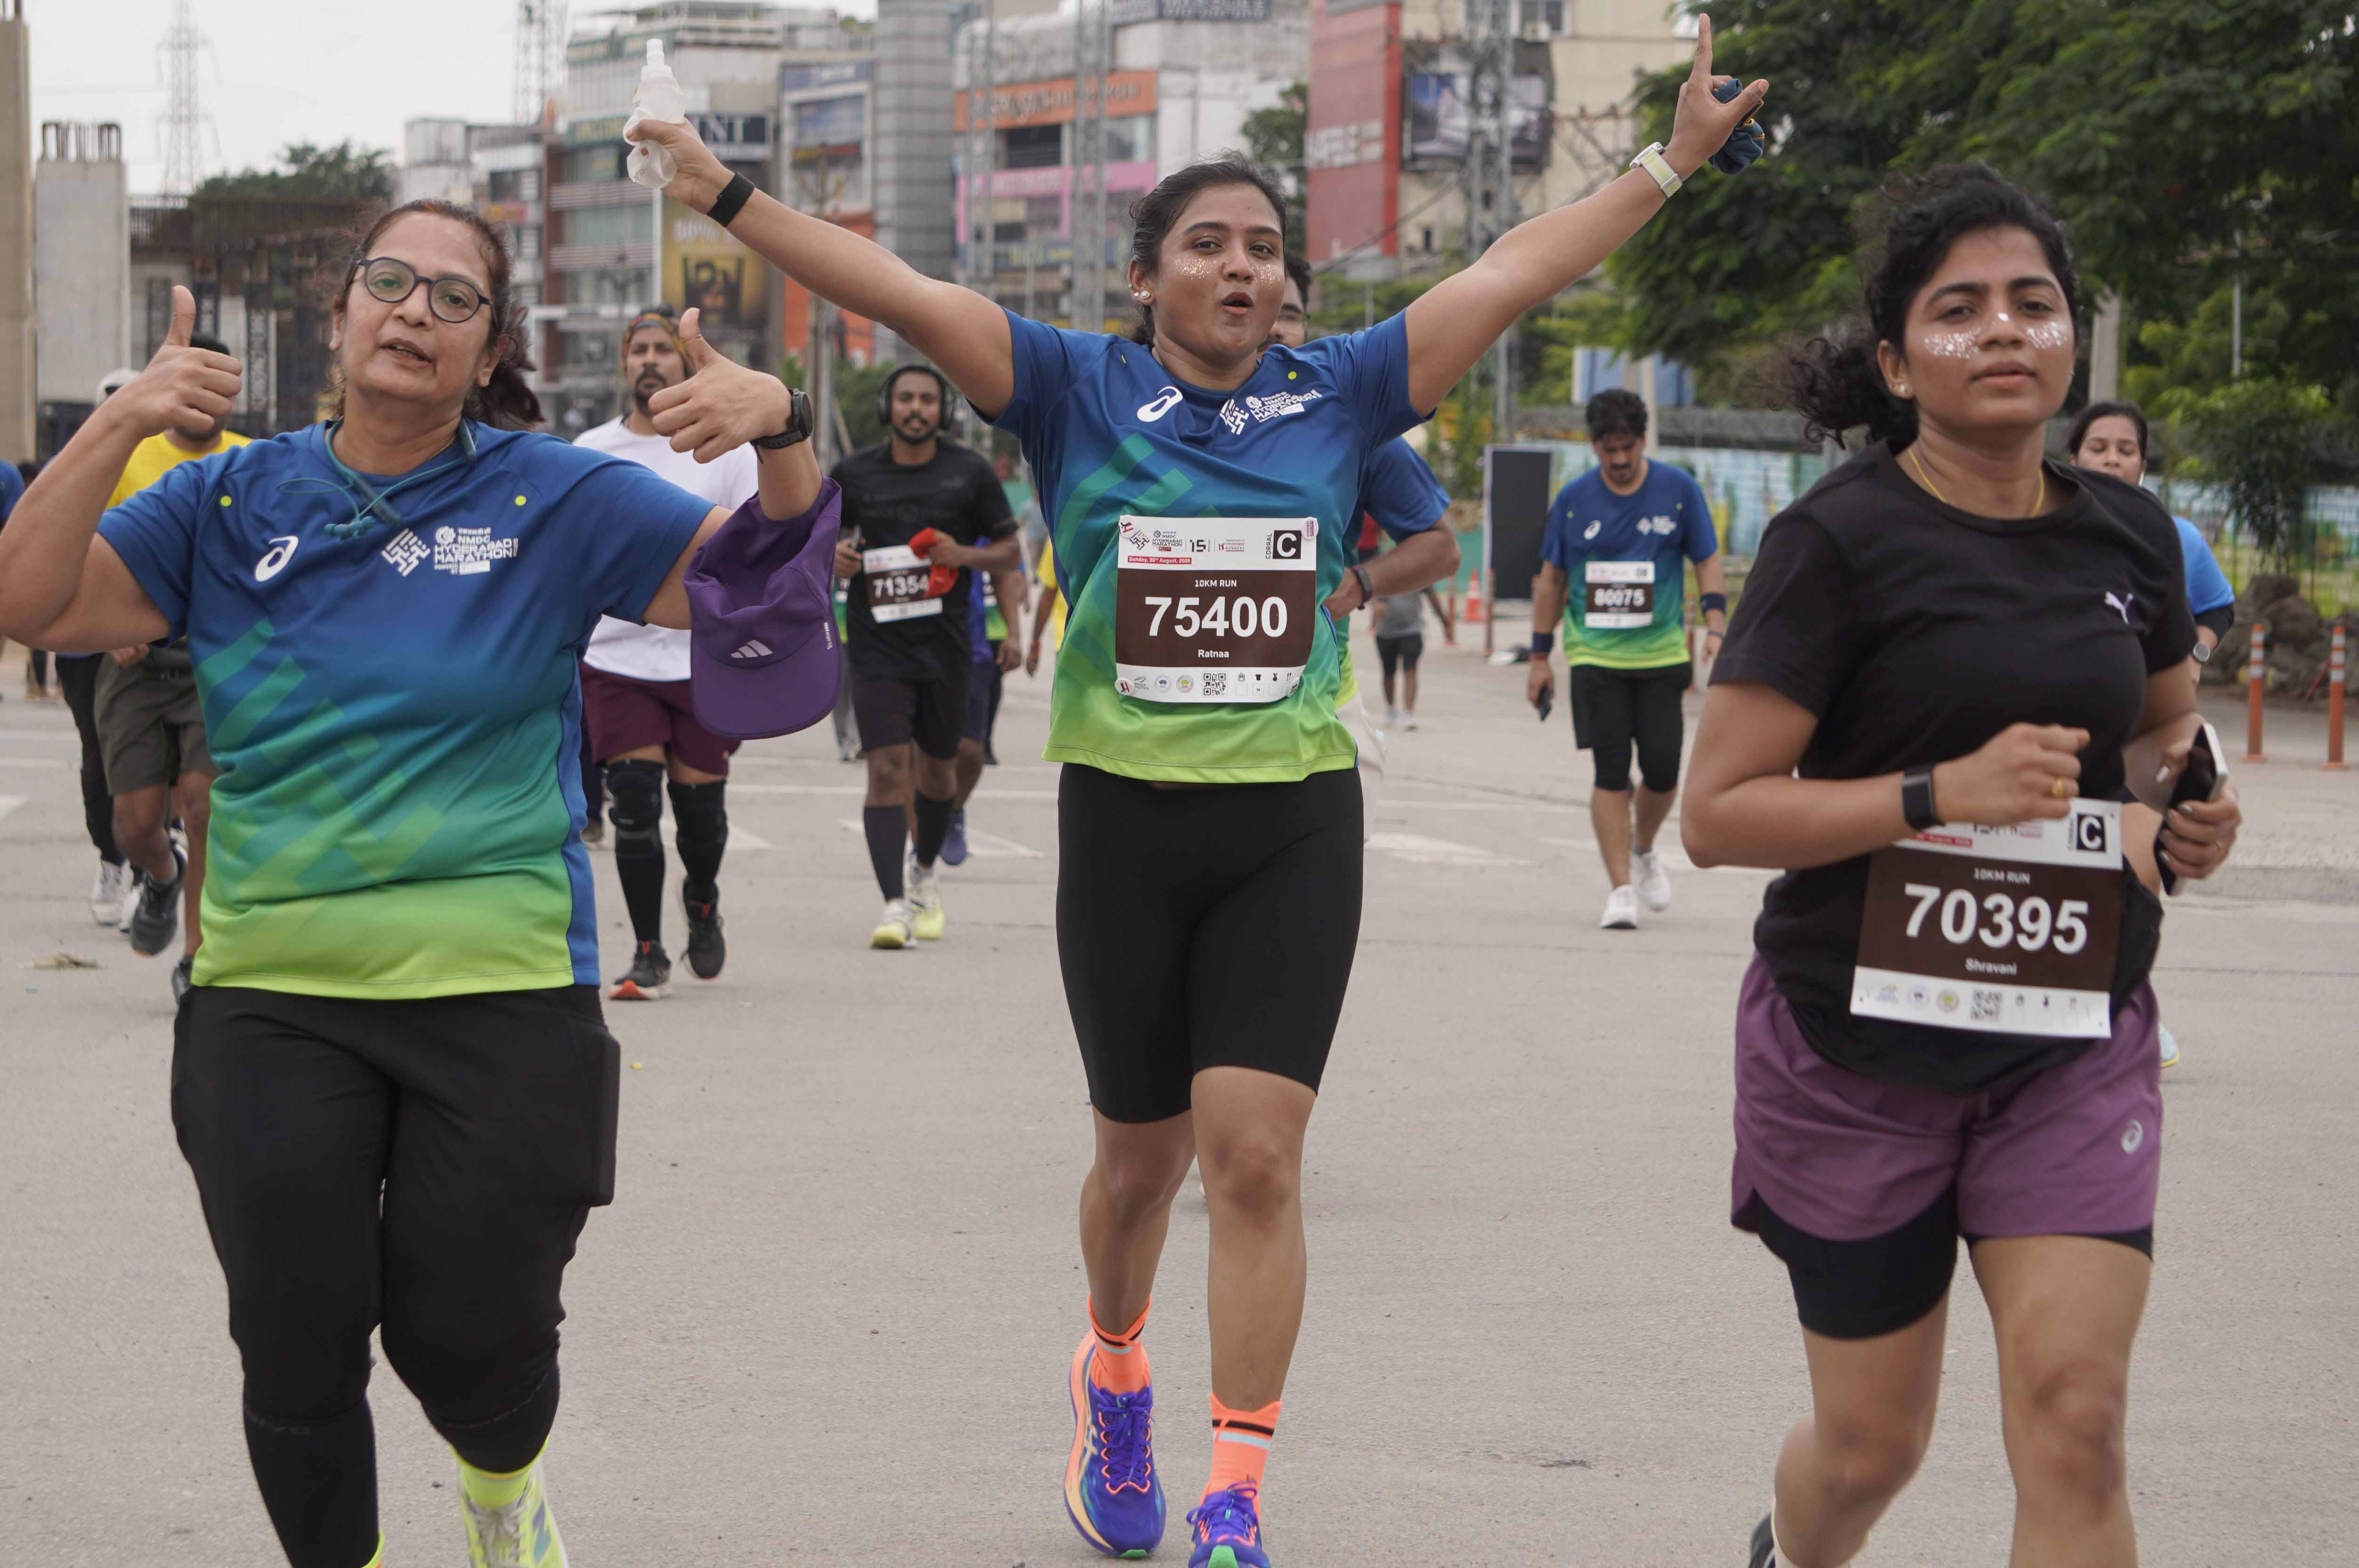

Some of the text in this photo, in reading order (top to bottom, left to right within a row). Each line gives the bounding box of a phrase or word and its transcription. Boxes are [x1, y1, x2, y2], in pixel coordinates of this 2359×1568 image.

[1264, 394, 1291, 405] NMDC
[435, 538, 513, 554] HYDERABAD
[458, 535, 491, 545] NMDC
[1190, 540, 1207, 552] 15
[1277, 533, 1297, 557] C
[435, 548, 513, 564] MARATHON
[1145, 596, 1287, 638] 75400
[1198, 649, 1229, 658] Ratnaa
[2078, 816, 2102, 850] C
[1973, 867, 2031, 884] 10KM RUN
[1904, 883, 2088, 955] 70395
[1965, 957, 2018, 976] Shravani
